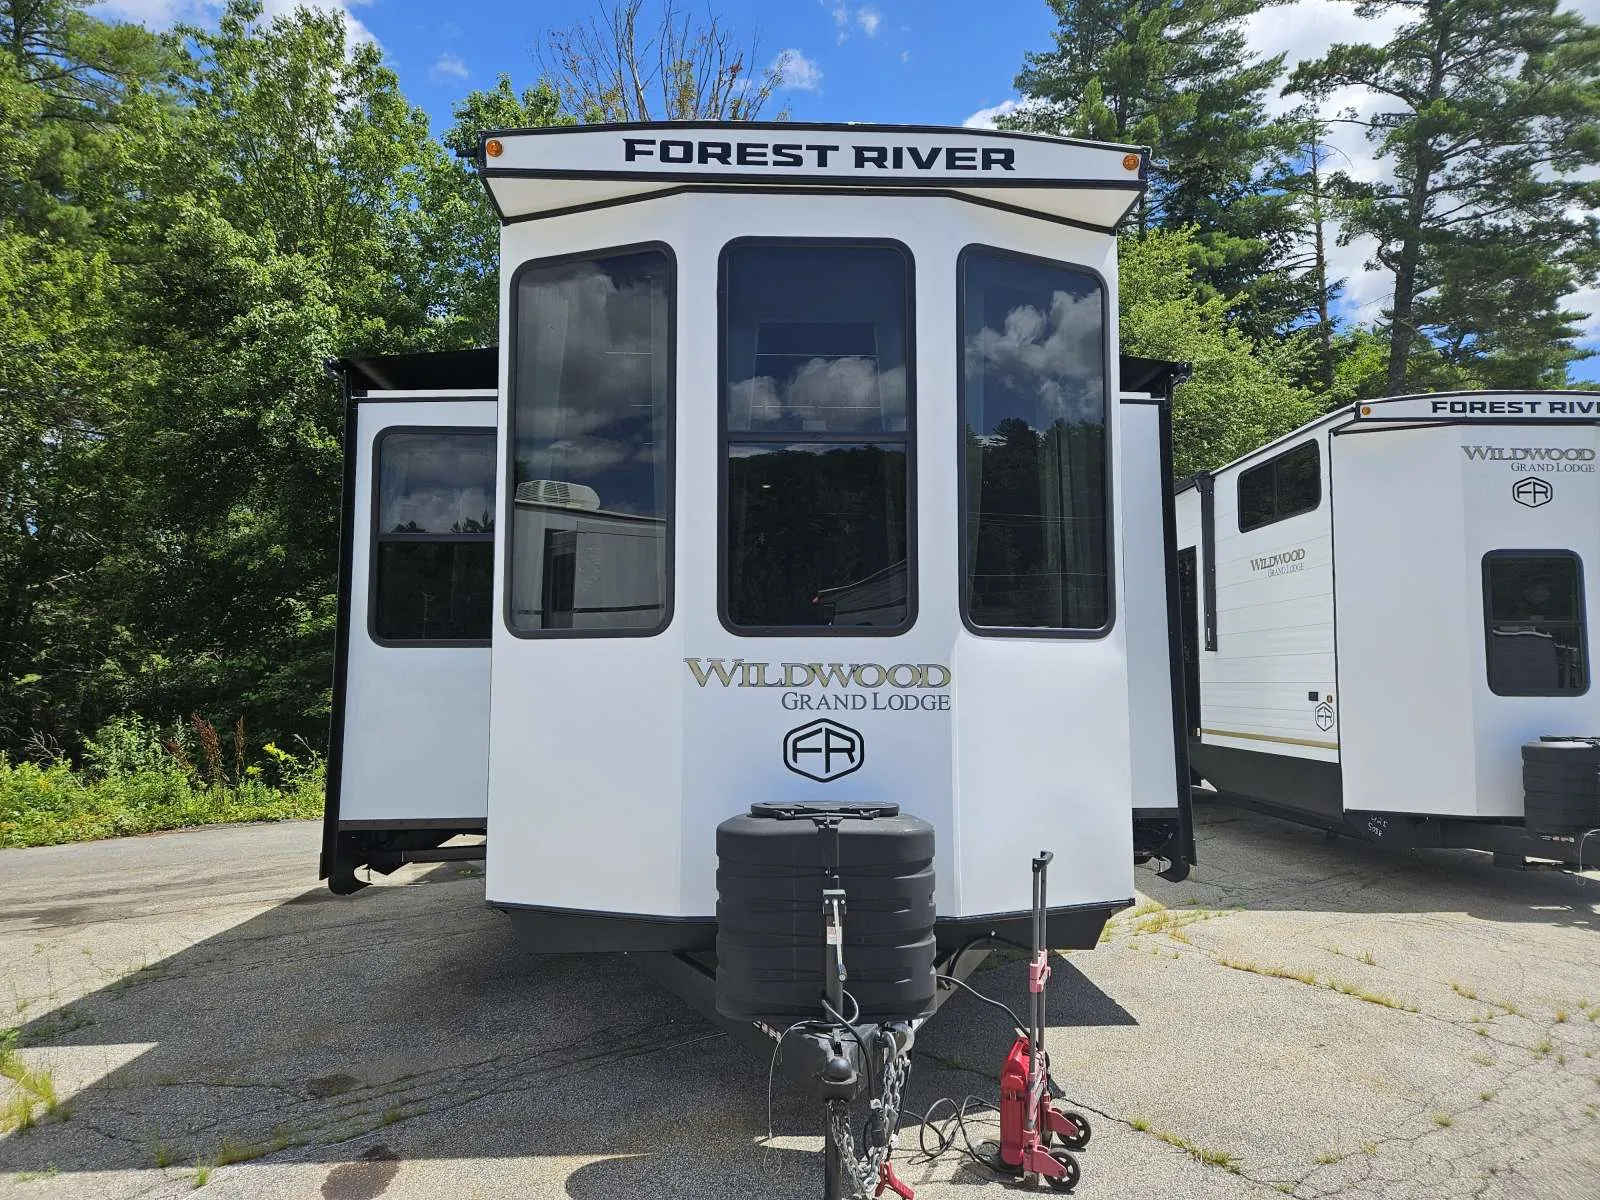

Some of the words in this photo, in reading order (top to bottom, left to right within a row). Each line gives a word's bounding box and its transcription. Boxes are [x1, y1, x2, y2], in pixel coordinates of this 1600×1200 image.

[622, 138, 839, 168] FOREST
[851, 145, 1016, 171] RIVER
[1431, 400, 1541, 414] FOREST
[1548, 401, 1600, 414] RIV
[1460, 445, 1596, 461] WILDWOOD
[1511, 462, 1554, 472] GRAND
[1556, 463, 1595, 473] LODGE
[1250, 548, 1305, 571] WILDWOOD
[683, 658, 952, 688] WILDWOOD
[781, 691, 867, 711] GRAND
[872, 692, 951, 711] LODGE
